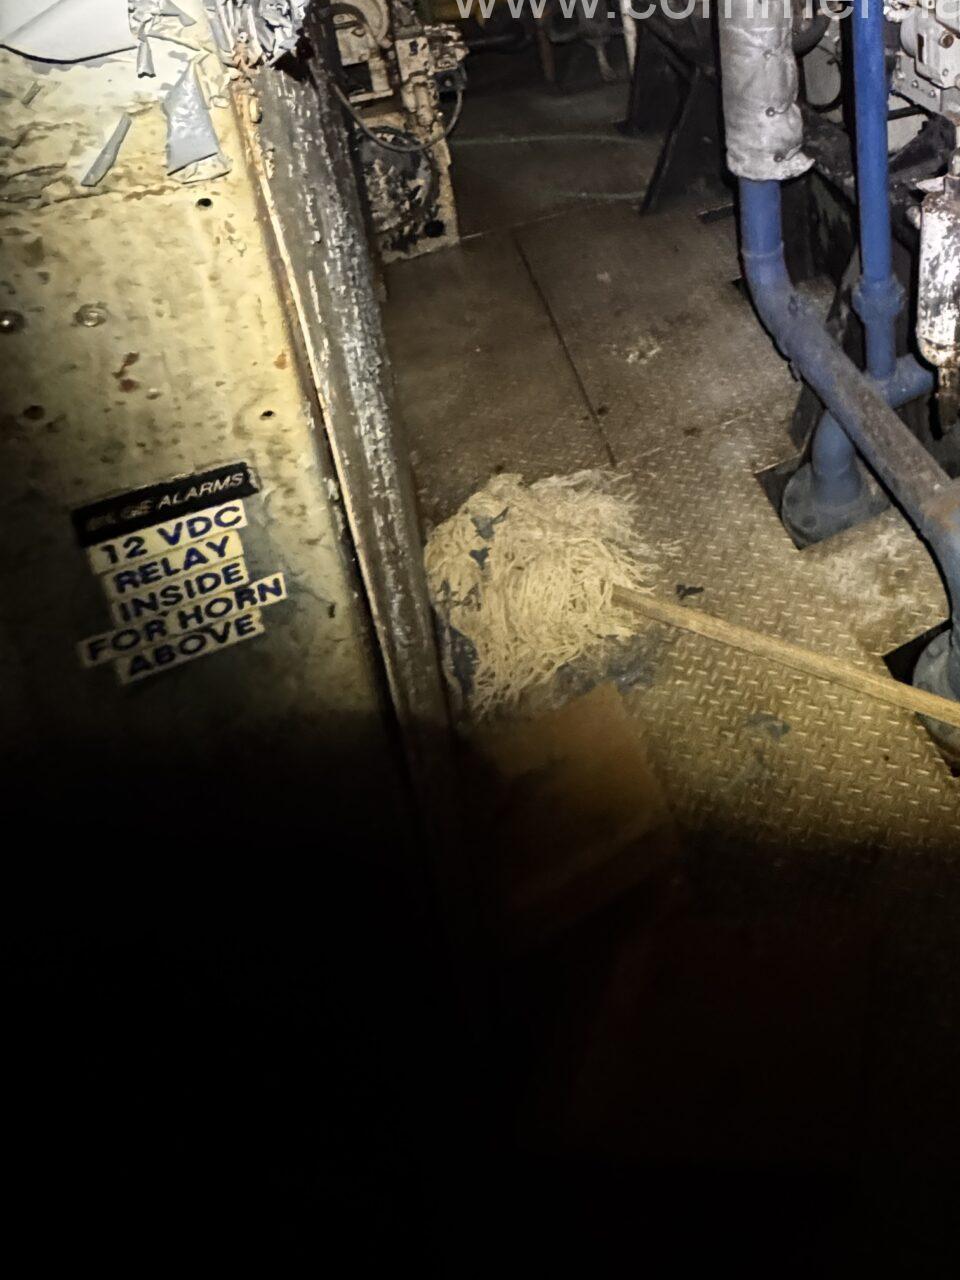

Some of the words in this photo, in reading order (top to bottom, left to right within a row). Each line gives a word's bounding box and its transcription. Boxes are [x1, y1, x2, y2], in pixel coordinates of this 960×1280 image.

[158, 472, 244, 510] ALARMS
[101, 536, 148, 564] 12
[157, 506, 243, 546] VDC
[113, 535, 231, 594] RELAY
[88, 619, 167, 661] FOR
[177, 577, 284, 629] HORN
[119, 562, 244, 622] INSIDE
[129, 613, 256, 676] ABOVE
